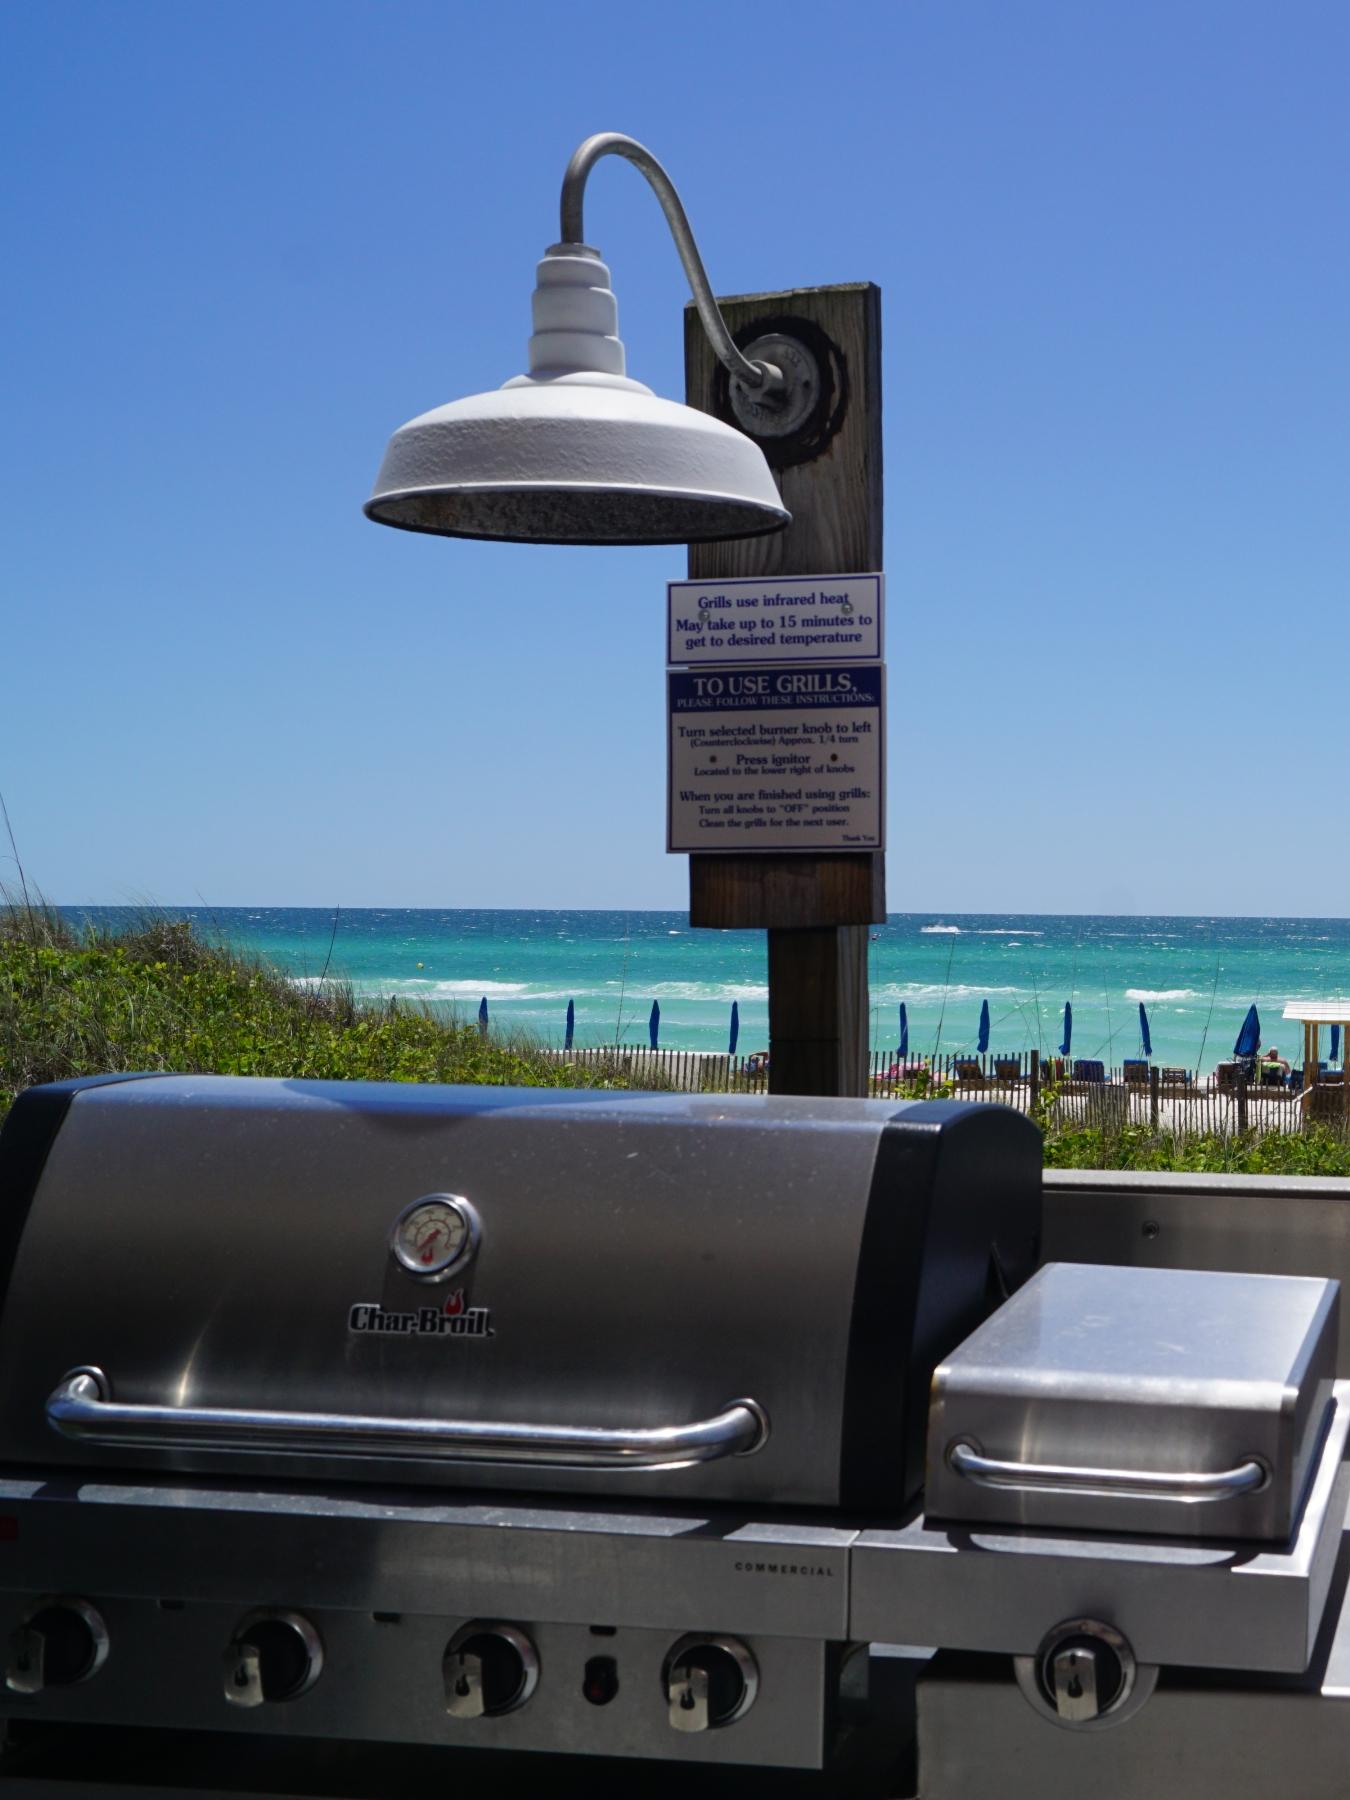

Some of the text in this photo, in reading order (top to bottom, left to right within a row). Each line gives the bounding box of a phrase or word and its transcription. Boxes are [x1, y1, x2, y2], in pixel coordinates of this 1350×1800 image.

[698, 592, 849, 609] Grills use infrared heat
[676, 615, 872, 633] May take up to 15 minutes to
[686, 632, 862, 650] get to desired temperature
[693, 673, 857, 696] TO USE GRILLS,
[677, 698, 714, 707] PLEASE
[716, 696, 757, 706] FOLLOW
[762, 695, 793, 705] THESE
[678, 721, 871, 737] Turn selected burner knob to left
[820, 735, 835, 744] 1/4
[839, 735, 858, 743] turn
[737, 752, 810, 765] Press ignitor
[694, 767, 729, 776] Located
[744, 767, 758, 775] the
[761, 766, 786, 774] lower
[790, 766, 811, 775] right
[815, 765, 824, 773] of
[827, 764, 855, 773] knobs
[680, 788, 870, 802] When you are finished using grills:
[699, 805, 720, 815] Turn
[723, 805, 734, 814] all
[737, 805, 764, 814] knobs
[766, 805, 775, 813] to
[812, 804, 850, 814] position
[699, 819, 724, 828] Clean
[728, 819, 742, 827] the
[744, 818, 767, 829] grills
[770, 818, 783, 827] for
[786, 818, 800, 826] the
[803, 818, 823, 826] next
[349, 1303, 489, 1337] Char-Broil
[734, 1562, 833, 1577] COMMERCIAL
